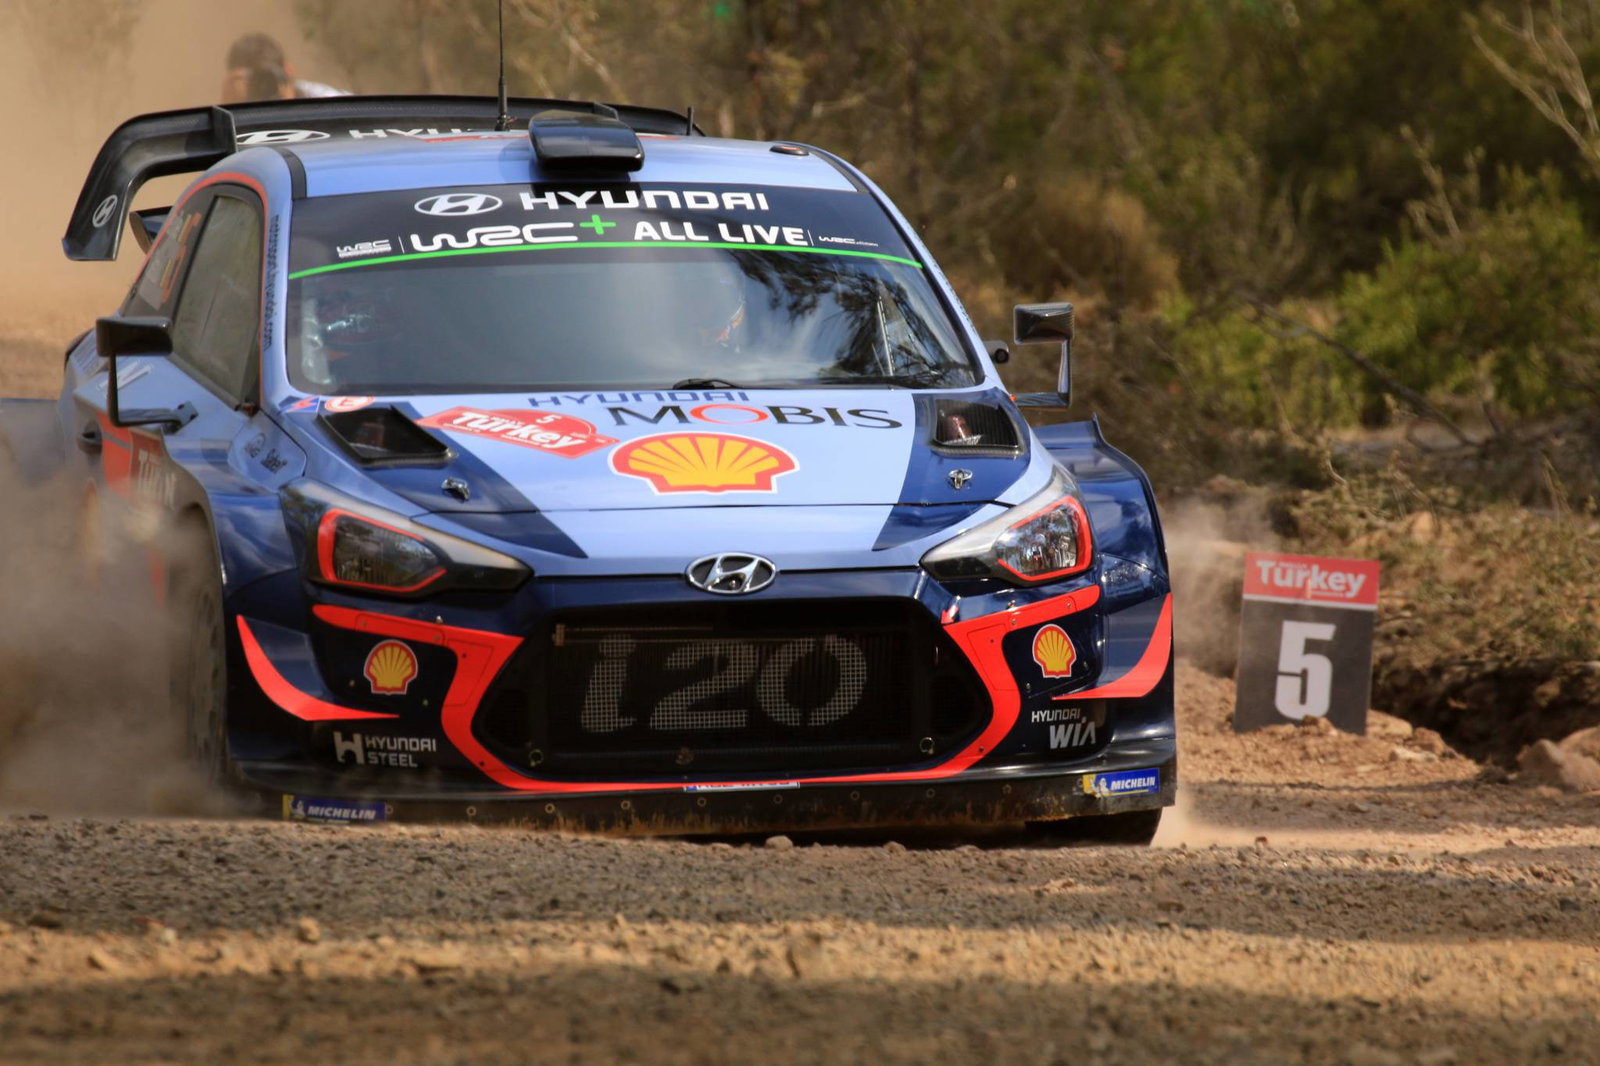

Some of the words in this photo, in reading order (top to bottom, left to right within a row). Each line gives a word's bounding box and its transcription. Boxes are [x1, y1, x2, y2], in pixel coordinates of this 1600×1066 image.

[519, 190, 769, 210] HYUNDAI
[634, 221, 709, 241] ALL
[718, 223, 808, 246] LIVE
[528, 392, 749, 407] HYUNDAI
[536, 414, 562, 424] 5
[607, 403, 903, 430] MOBIS
[452, 411, 588, 449] Turkey
[1255, 560, 1367, 598] Turkey
[1275, 620, 1337, 720] 5
[1031, 708, 1080, 723] HYUNDAI
[365, 736, 436, 752] HYUNDAI
[367, 751, 418, 768] STEEL
[1110, 776, 1156, 791] MICHELIN
[307, 806, 377, 819] MICHELIN
